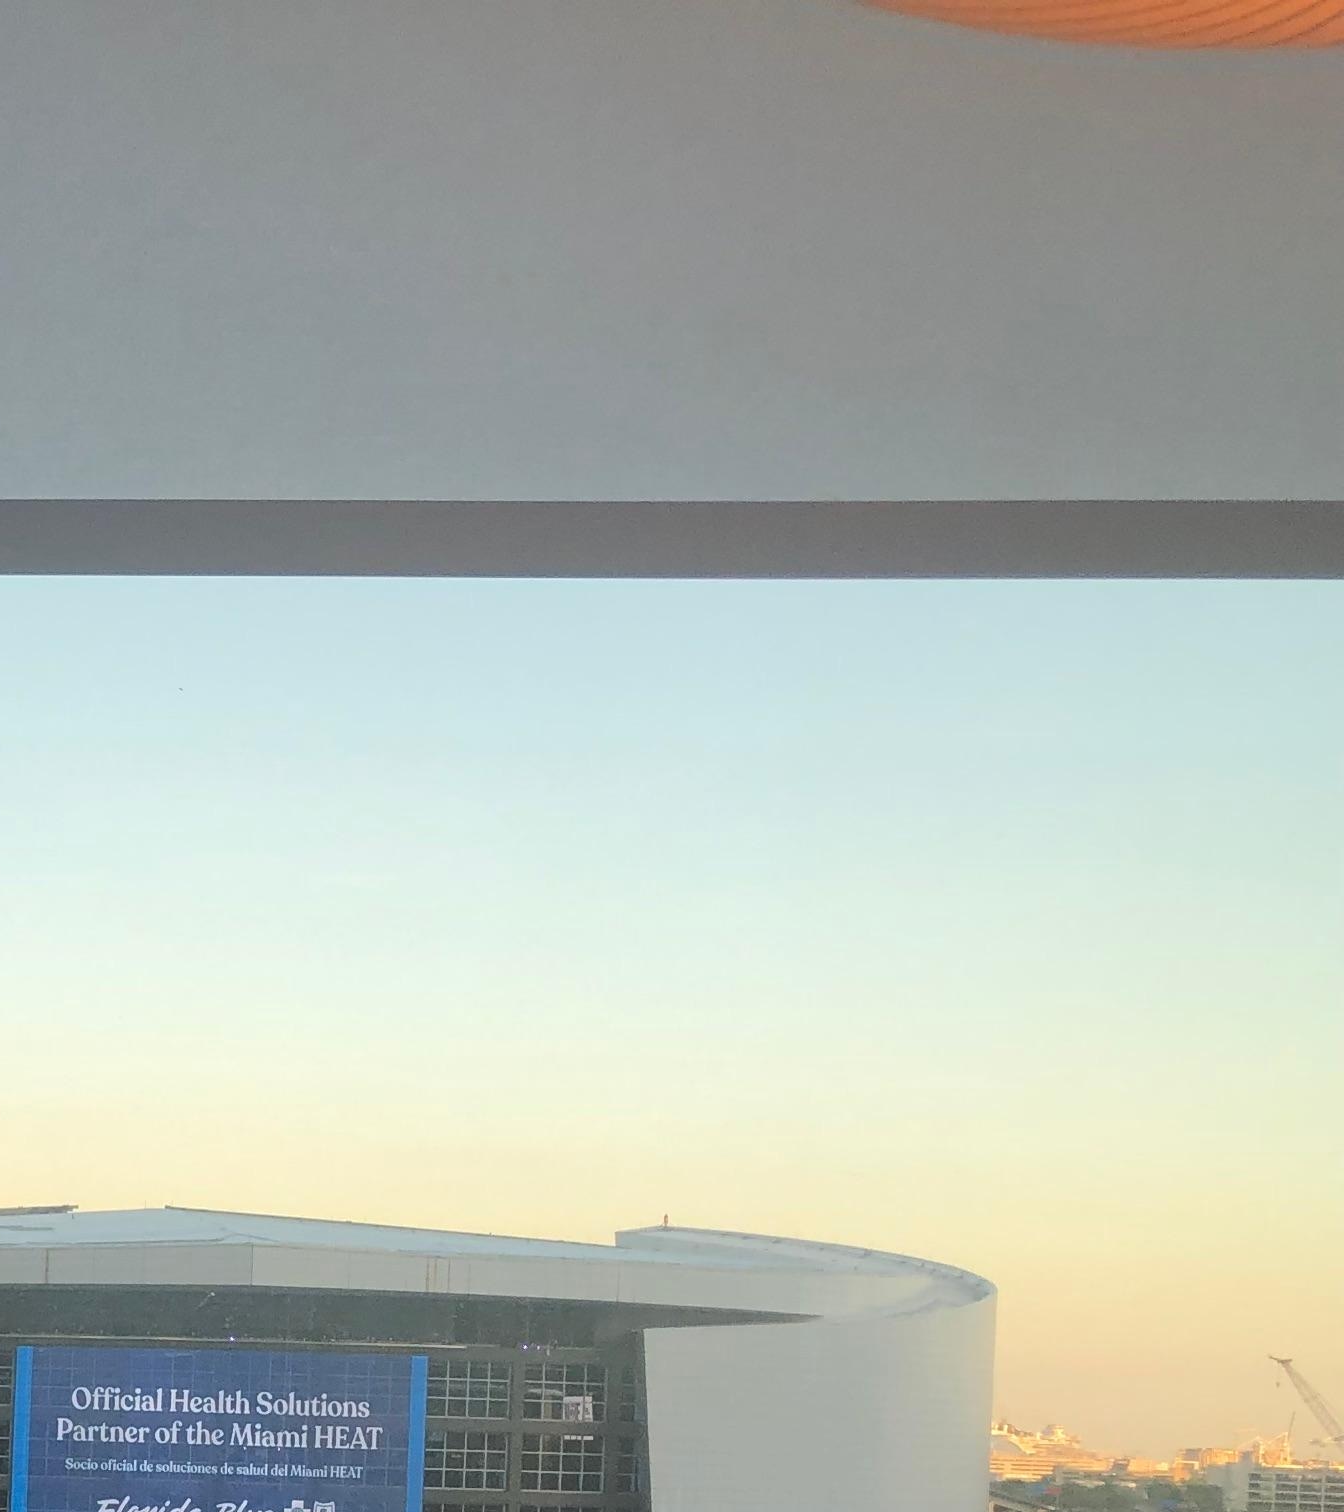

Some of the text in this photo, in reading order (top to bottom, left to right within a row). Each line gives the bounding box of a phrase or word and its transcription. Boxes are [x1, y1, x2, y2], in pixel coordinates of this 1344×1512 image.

[71, 1385, 371, 1418] Official Health Solutions
[56, 1417, 384, 1450] Partner of the Miami HEAT
[64, 1457, 364, 1479] Socio oficial de soluciones de salud del Miami HEAT
